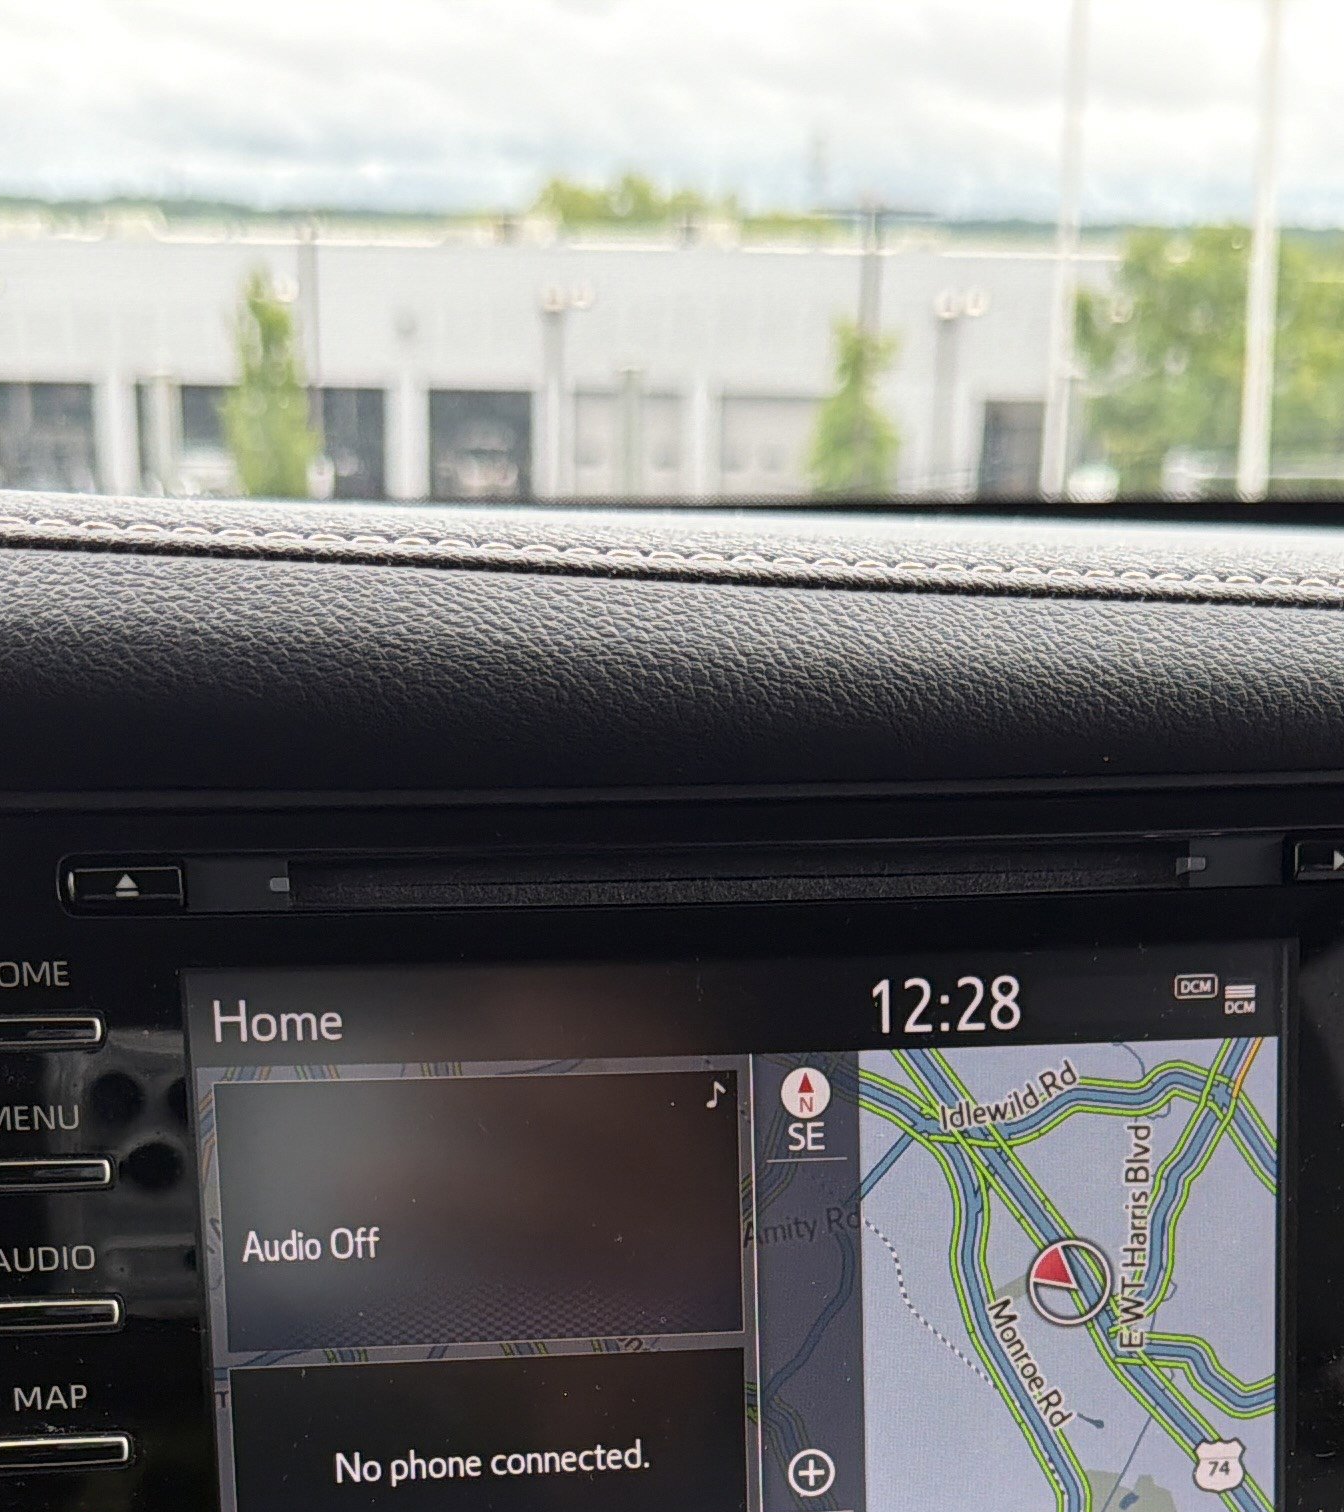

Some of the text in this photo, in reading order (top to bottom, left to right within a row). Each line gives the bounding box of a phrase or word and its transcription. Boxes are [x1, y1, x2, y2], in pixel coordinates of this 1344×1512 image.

[870, 975, 1023, 1034] 12:28
[1180, 979, 1212, 994] DCM
[212, 1000, 344, 1043] Home
[1224, 1000, 1256, 1015] DCM
[798, 1096, 814, 1114] N
[939, 1060, 1078, 1131] Idlewild Rd
[787, 1120, 827, 1152] SE
[1124, 1124, 1152, 1184] Blvd
[241, 1229, 323, 1263] Audio
[330, 1226, 381, 1260] Off
[1122, 1191, 1149, 1268] Harris
[1119, 1331, 1144, 1350] E
[988, 1297, 1073, 1428] Monroe Rd
[12, 1385, 89, 1412] MAP
[334, 1438, 651, 1488] No phone connected.
[1208, 1460, 1231, 1477] 74
